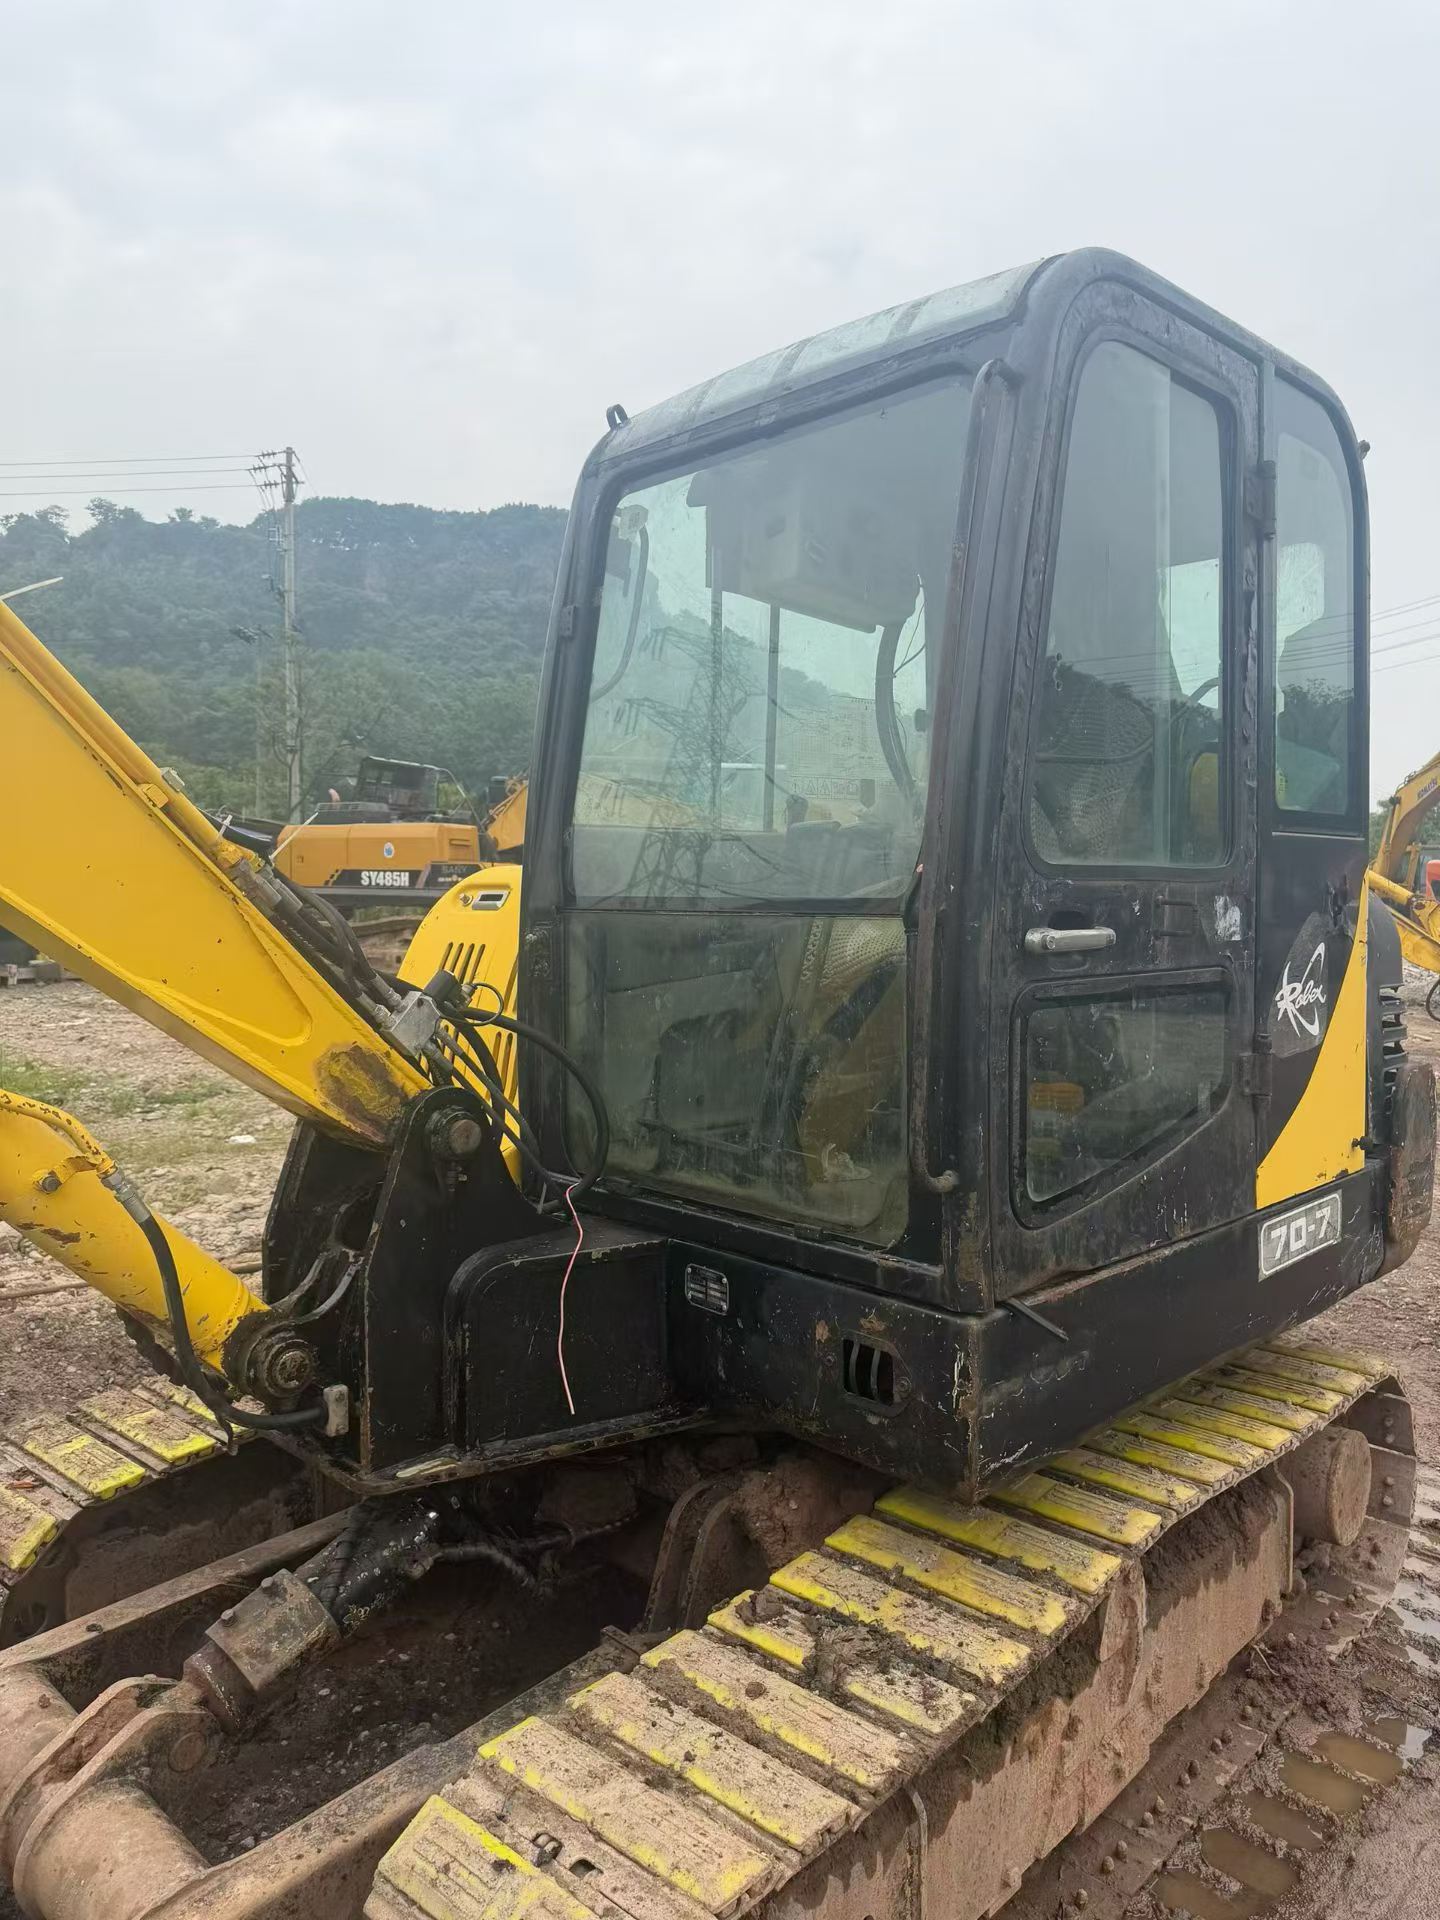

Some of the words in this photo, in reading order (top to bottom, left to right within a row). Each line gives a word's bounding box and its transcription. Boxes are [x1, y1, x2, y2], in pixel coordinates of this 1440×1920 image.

[361, 871, 409, 887] SY485H
[1275, 961, 1327, 1037] Robex
[1270, 1206, 1331, 1260] 70-7
